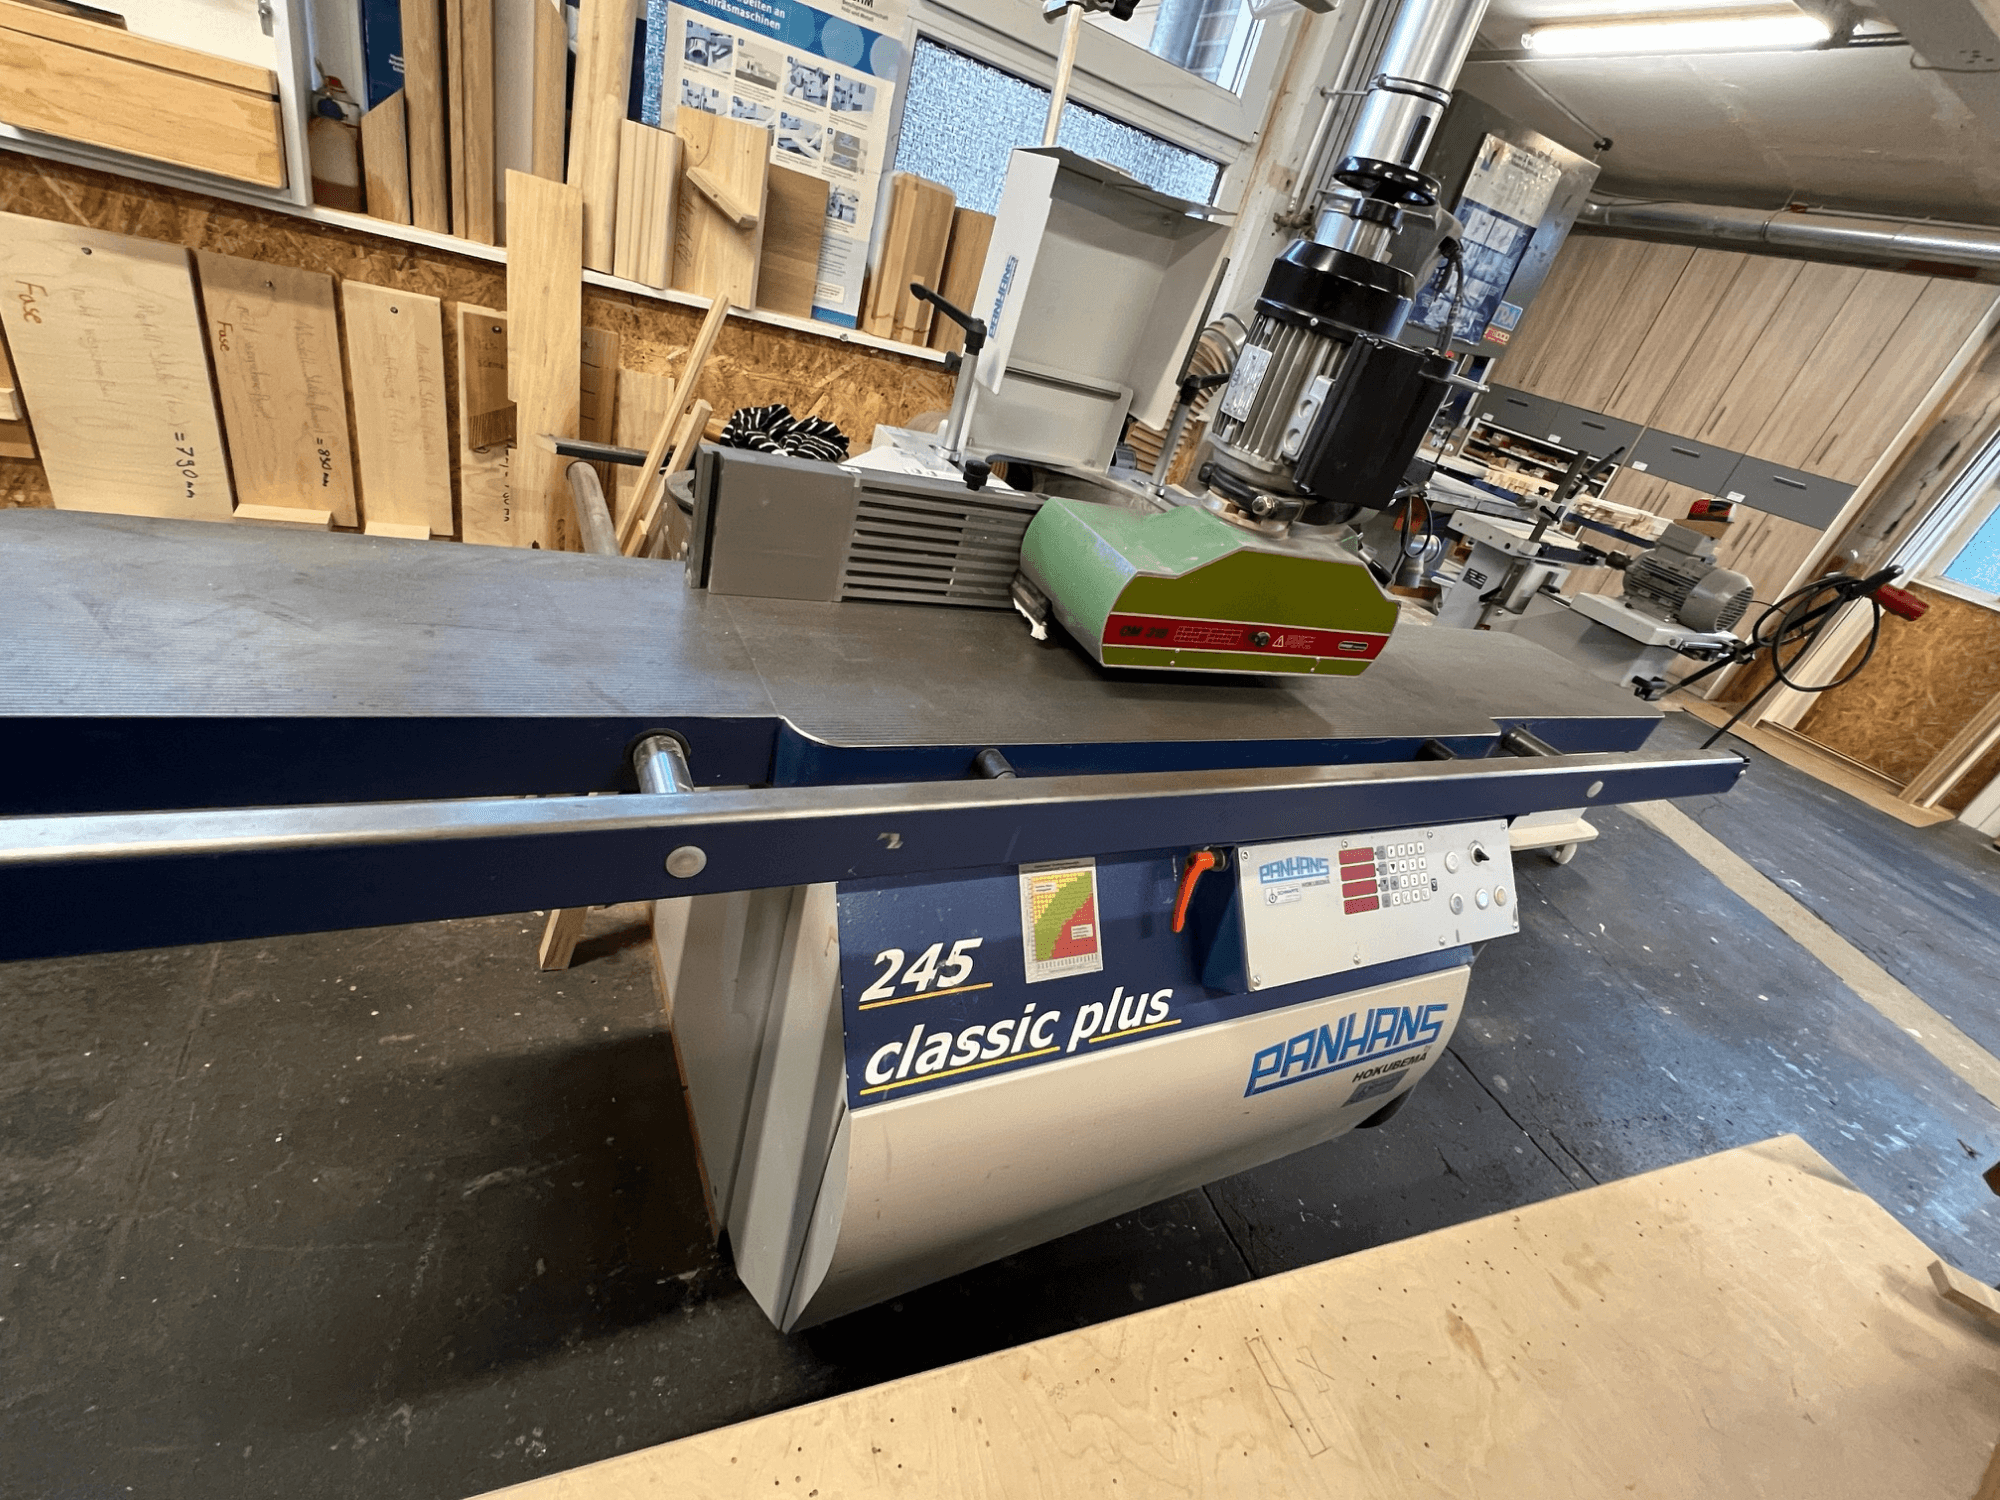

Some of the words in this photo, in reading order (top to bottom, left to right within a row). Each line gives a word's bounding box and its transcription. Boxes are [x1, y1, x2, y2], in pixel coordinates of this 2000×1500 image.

[773, 7, 786, 19] an
[15, 281, 43, 326] Fase
[217, 321, 231, 352] Fase
[1259, 856, 1329, 884] PANHANS
[859, 937, 983, 1002] 245
[864, 1002, 1061, 1086] classic
[1066, 986, 1173, 1053] plus
[1244, 1004, 1448, 1098] PANHANS
[1352, 1052, 1427, 1083] HOKUBEMA
